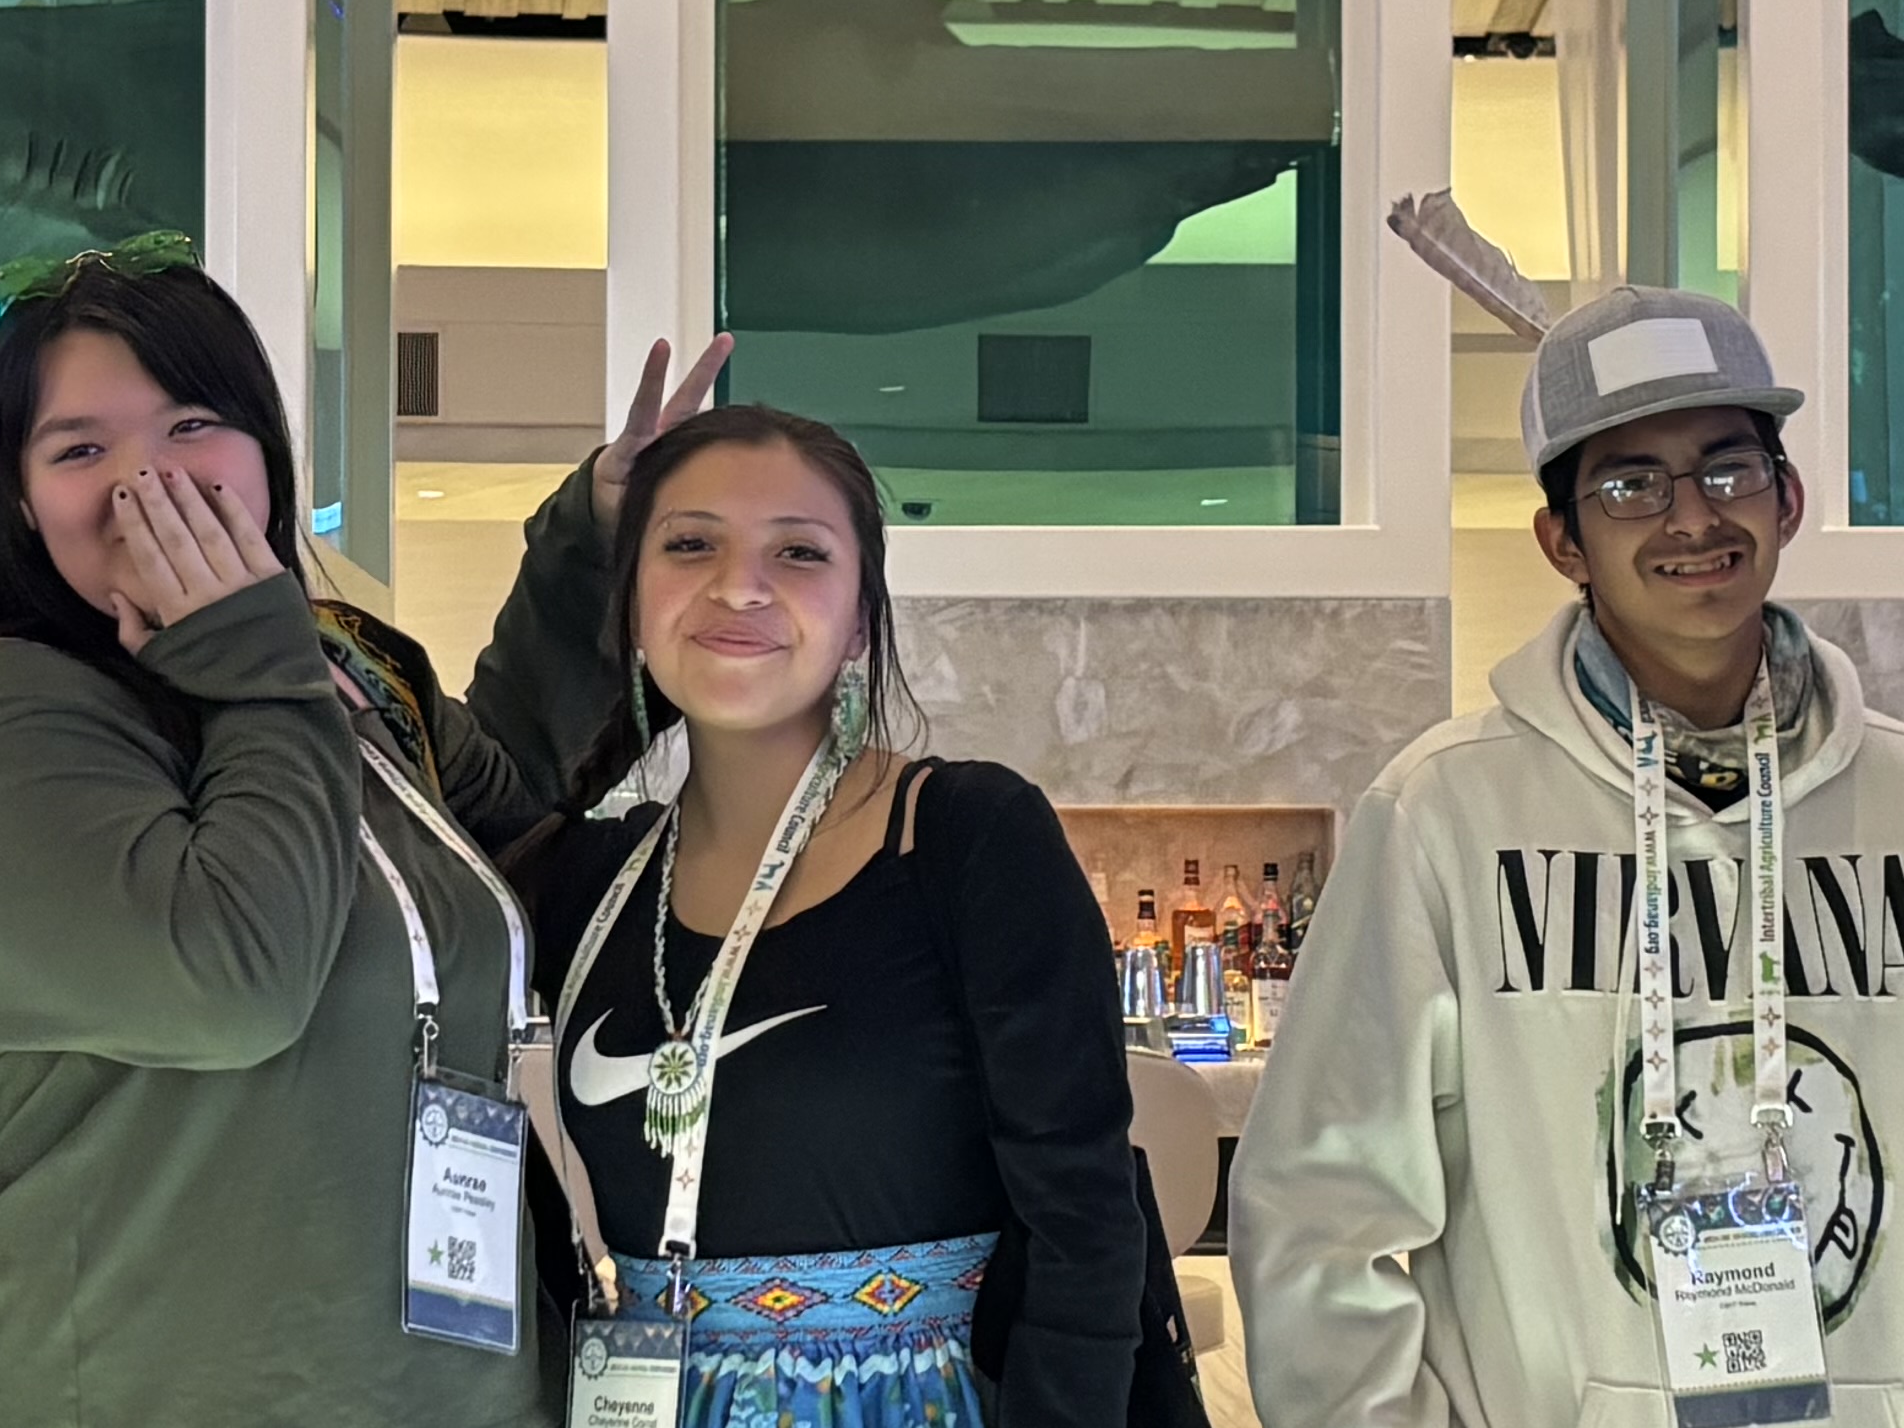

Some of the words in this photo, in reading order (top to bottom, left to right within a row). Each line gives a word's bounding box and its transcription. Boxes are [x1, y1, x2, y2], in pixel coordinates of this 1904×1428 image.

[1754, 752, 1771, 798] Council
[776, 814, 805, 854] Council
[1757, 799, 1777, 872] Agriculture
[1643, 830, 1662, 955] www.indianag.org
[1759, 874, 1775, 942] Intertribal
[1675, 1286, 1732, 1301] Raymond
[1734, 1279, 1795, 1295] McDonald
[1692, 1262, 1776, 1286] Raymond
[594, 1395, 655, 1416] Cheyenne
